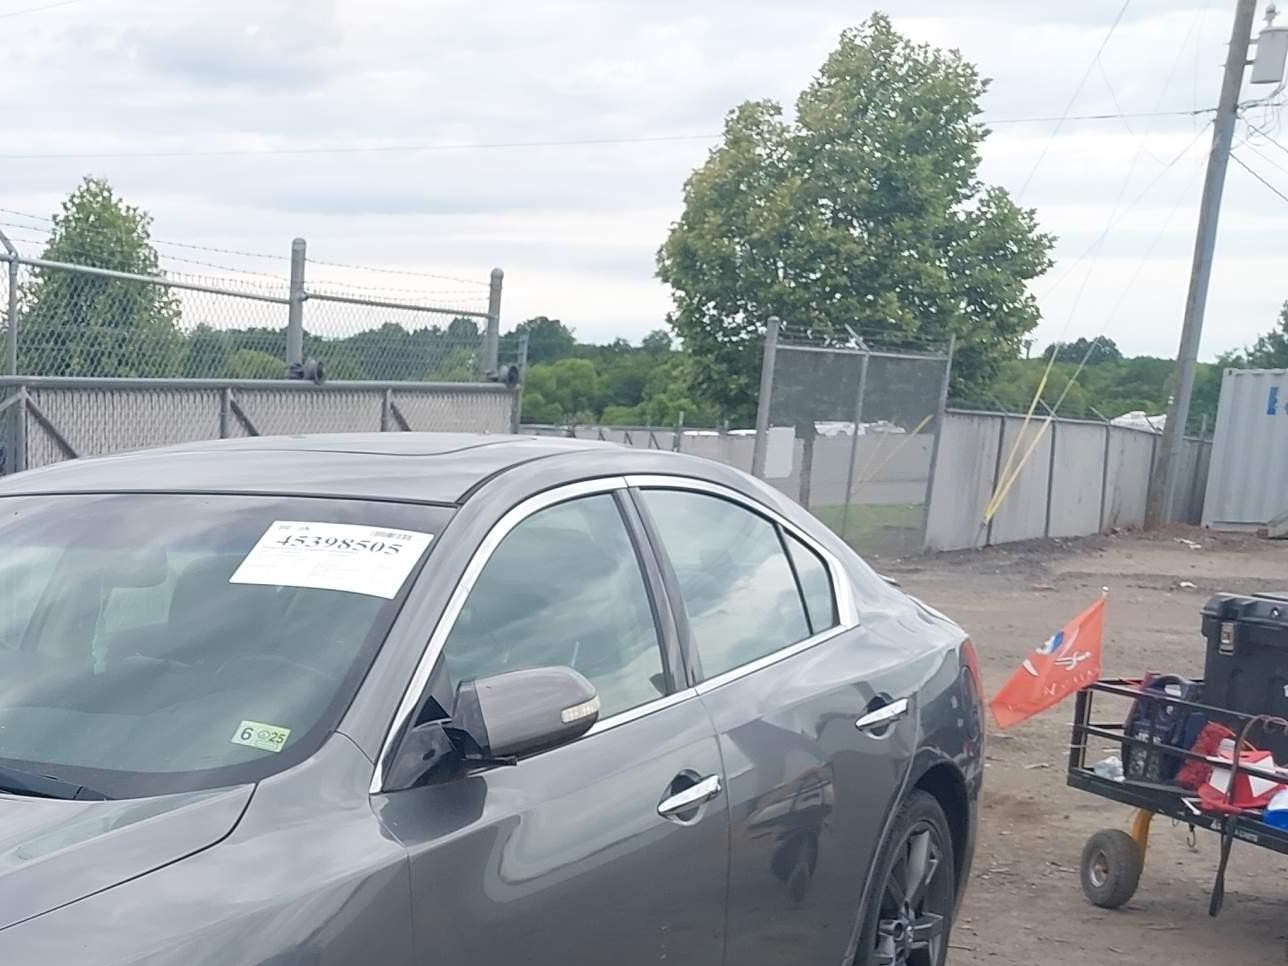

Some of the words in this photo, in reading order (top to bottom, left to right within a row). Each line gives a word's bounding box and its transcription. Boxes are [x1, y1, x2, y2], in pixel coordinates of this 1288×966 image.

[275, 534, 404, 556] 45398505
[240, 727, 254, 741] 6
[268, 731, 286, 744] 25
